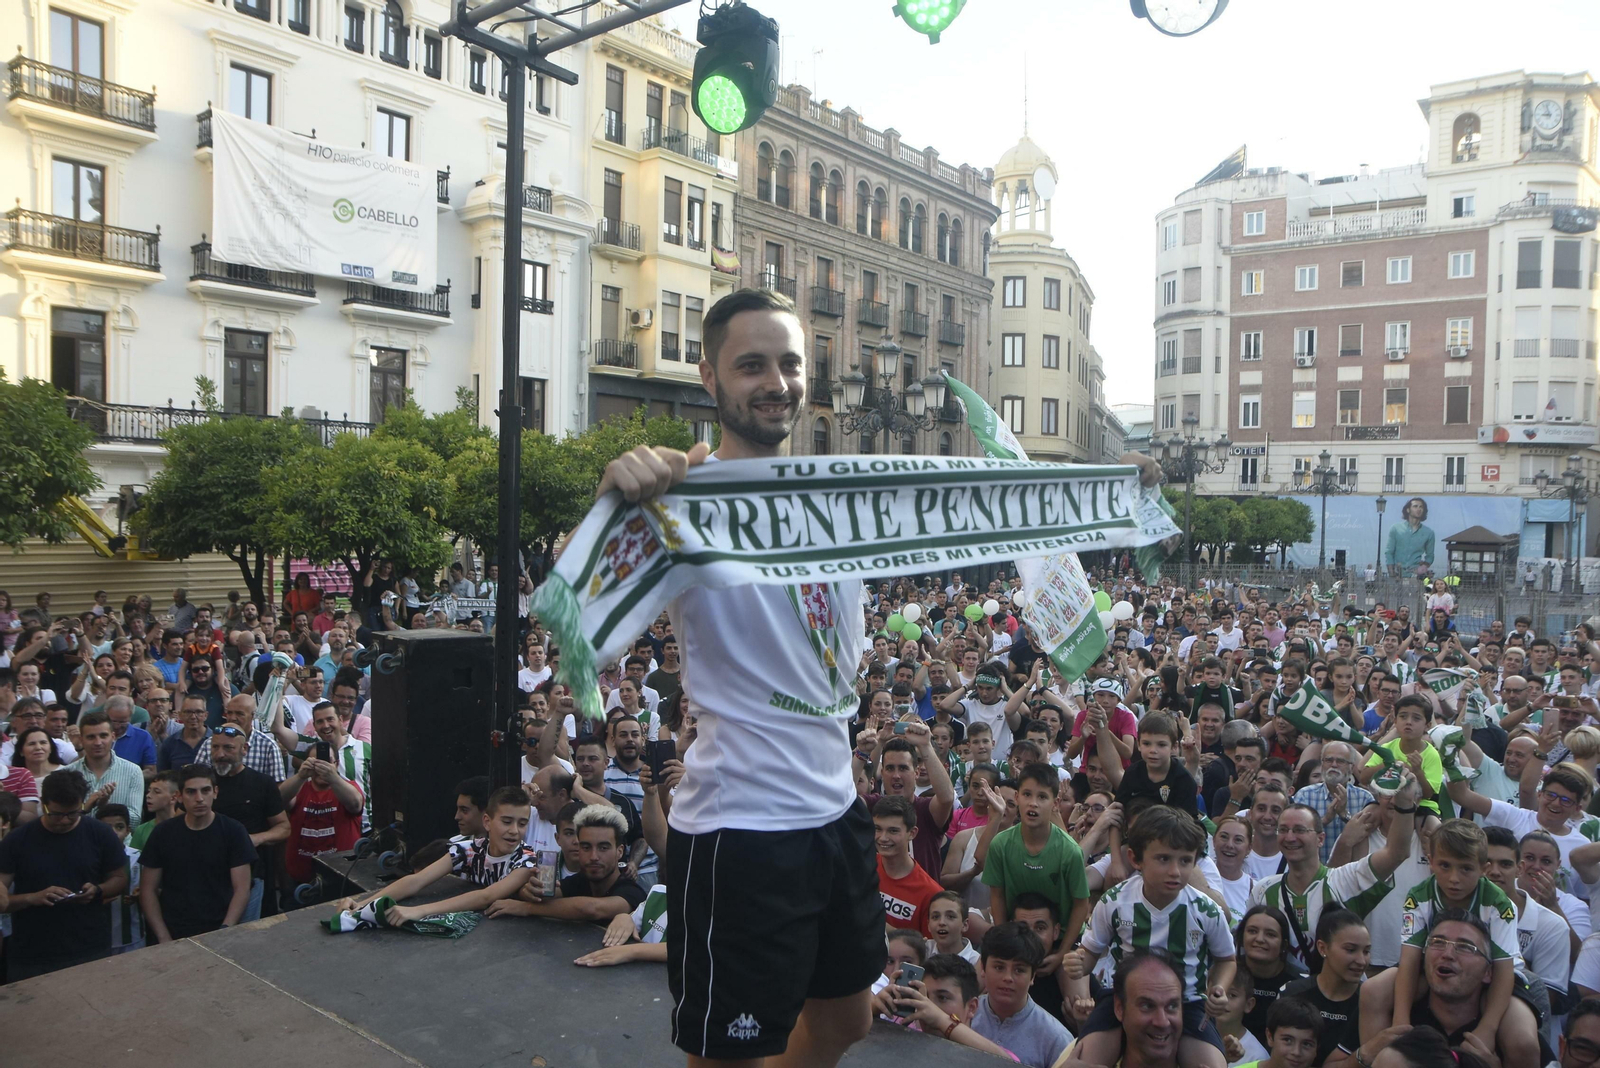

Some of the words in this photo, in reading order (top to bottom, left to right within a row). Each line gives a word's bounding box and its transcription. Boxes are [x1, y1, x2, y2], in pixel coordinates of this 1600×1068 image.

[308, 143, 333, 159] H10
[333, 152, 371, 168] palacio
[372, 161, 420, 179] colomera
[357, 206, 419, 228] CABELLO
[770, 463, 816, 478] TU
[828, 459, 940, 475] GLORIA
[945, 459, 978, 469] MI
[683, 488, 902, 551] FRENTE
[914, 478, 1131, 536] PENITENTE
[754, 565, 811, 579] TUS
[818, 550, 941, 574] COLORES
[945, 547, 973, 561] MI
[981, 530, 1107, 557] PENITENCIA
[727, 1026, 760, 1040] Kappa
